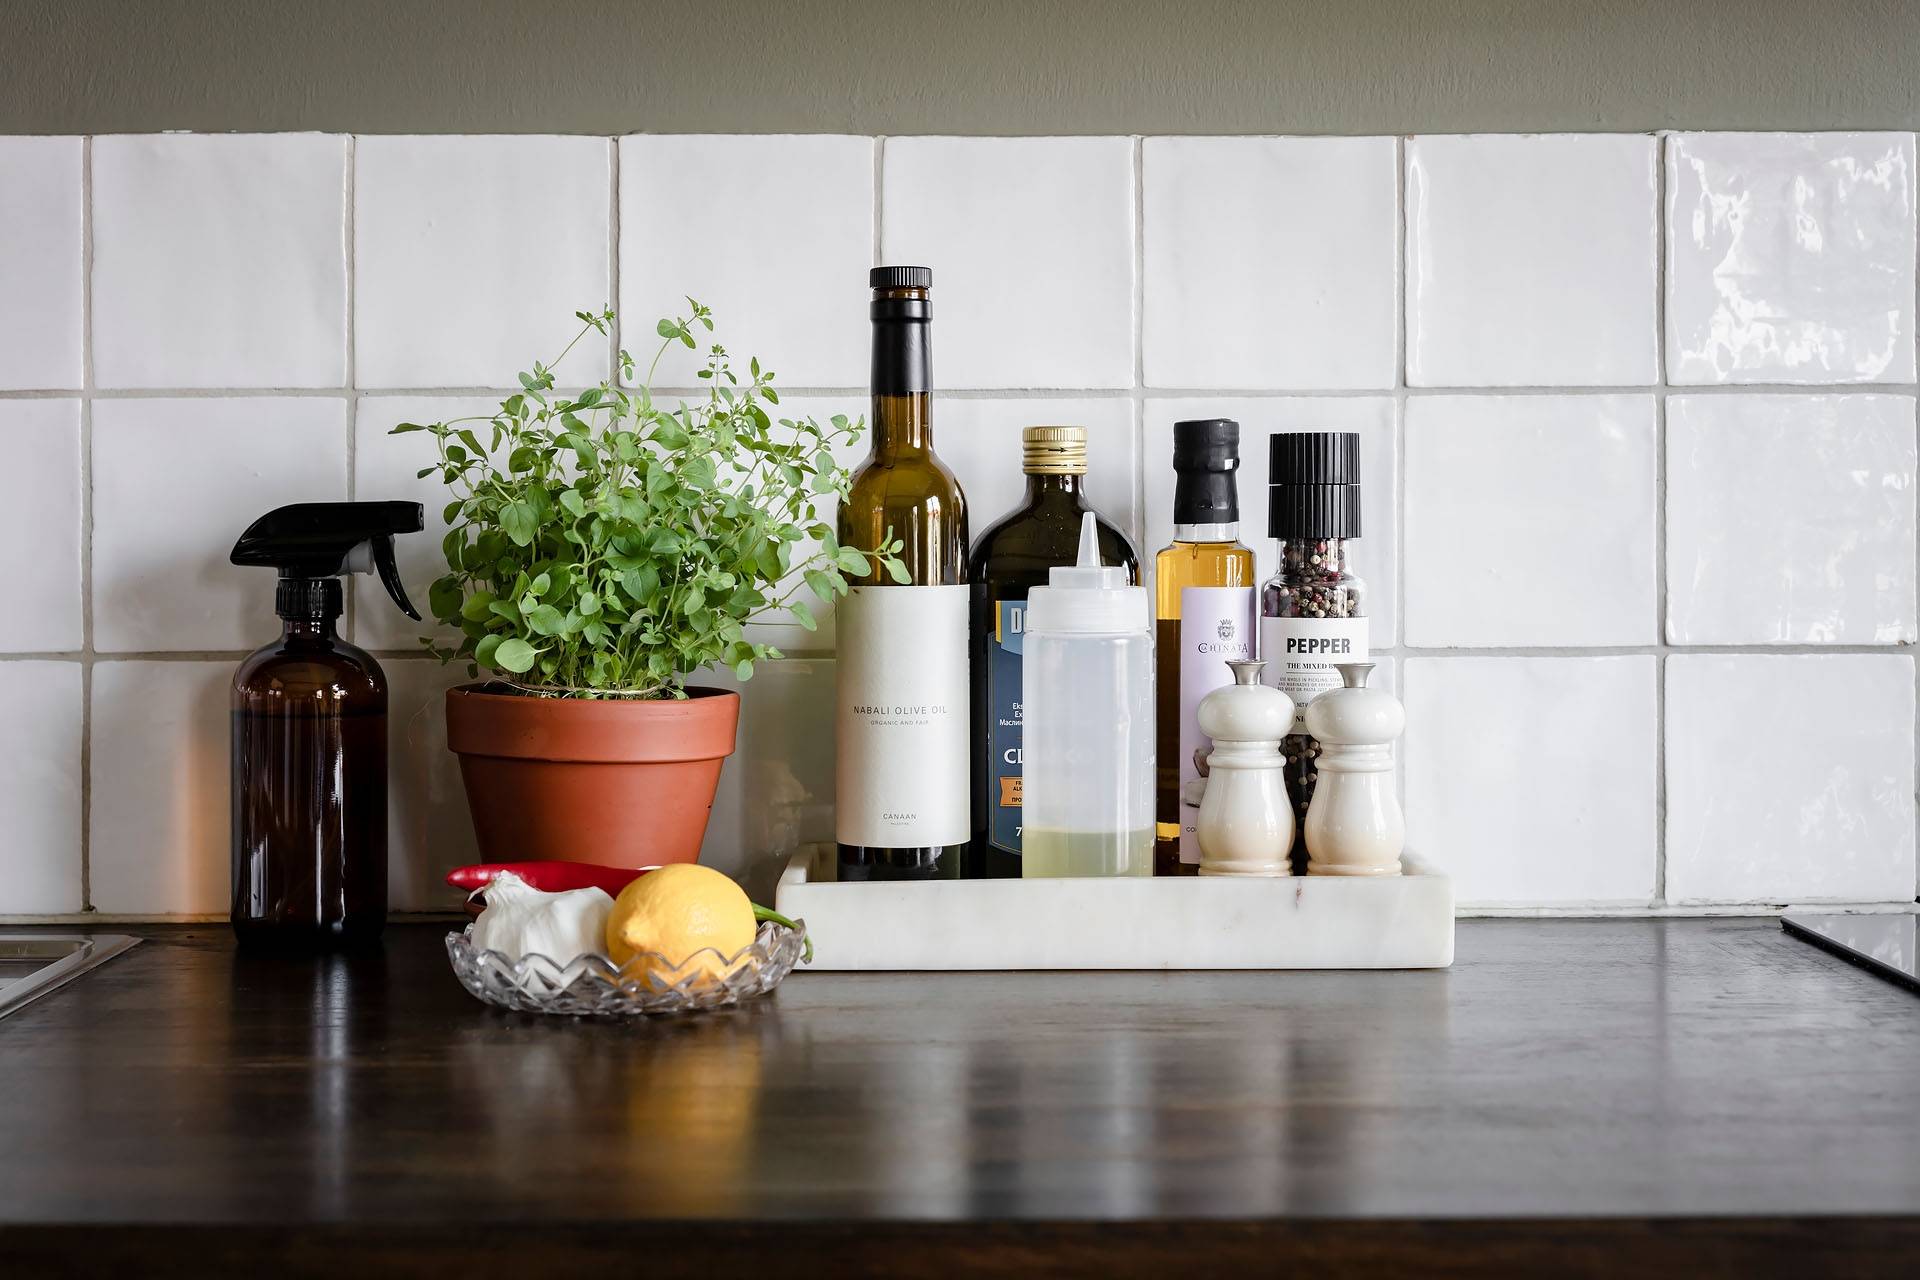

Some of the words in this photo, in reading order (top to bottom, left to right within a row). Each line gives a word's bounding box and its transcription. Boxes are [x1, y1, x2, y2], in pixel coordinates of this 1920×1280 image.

[1010, 607, 1027, 634] D
[1198, 642, 1248, 654] CHINATA
[1286, 638, 1351, 654] PEPPER
[853, 706, 890, 715] NABALI
[894, 706, 927, 715] OLIVE
[931, 705, 947, 714] OIL
